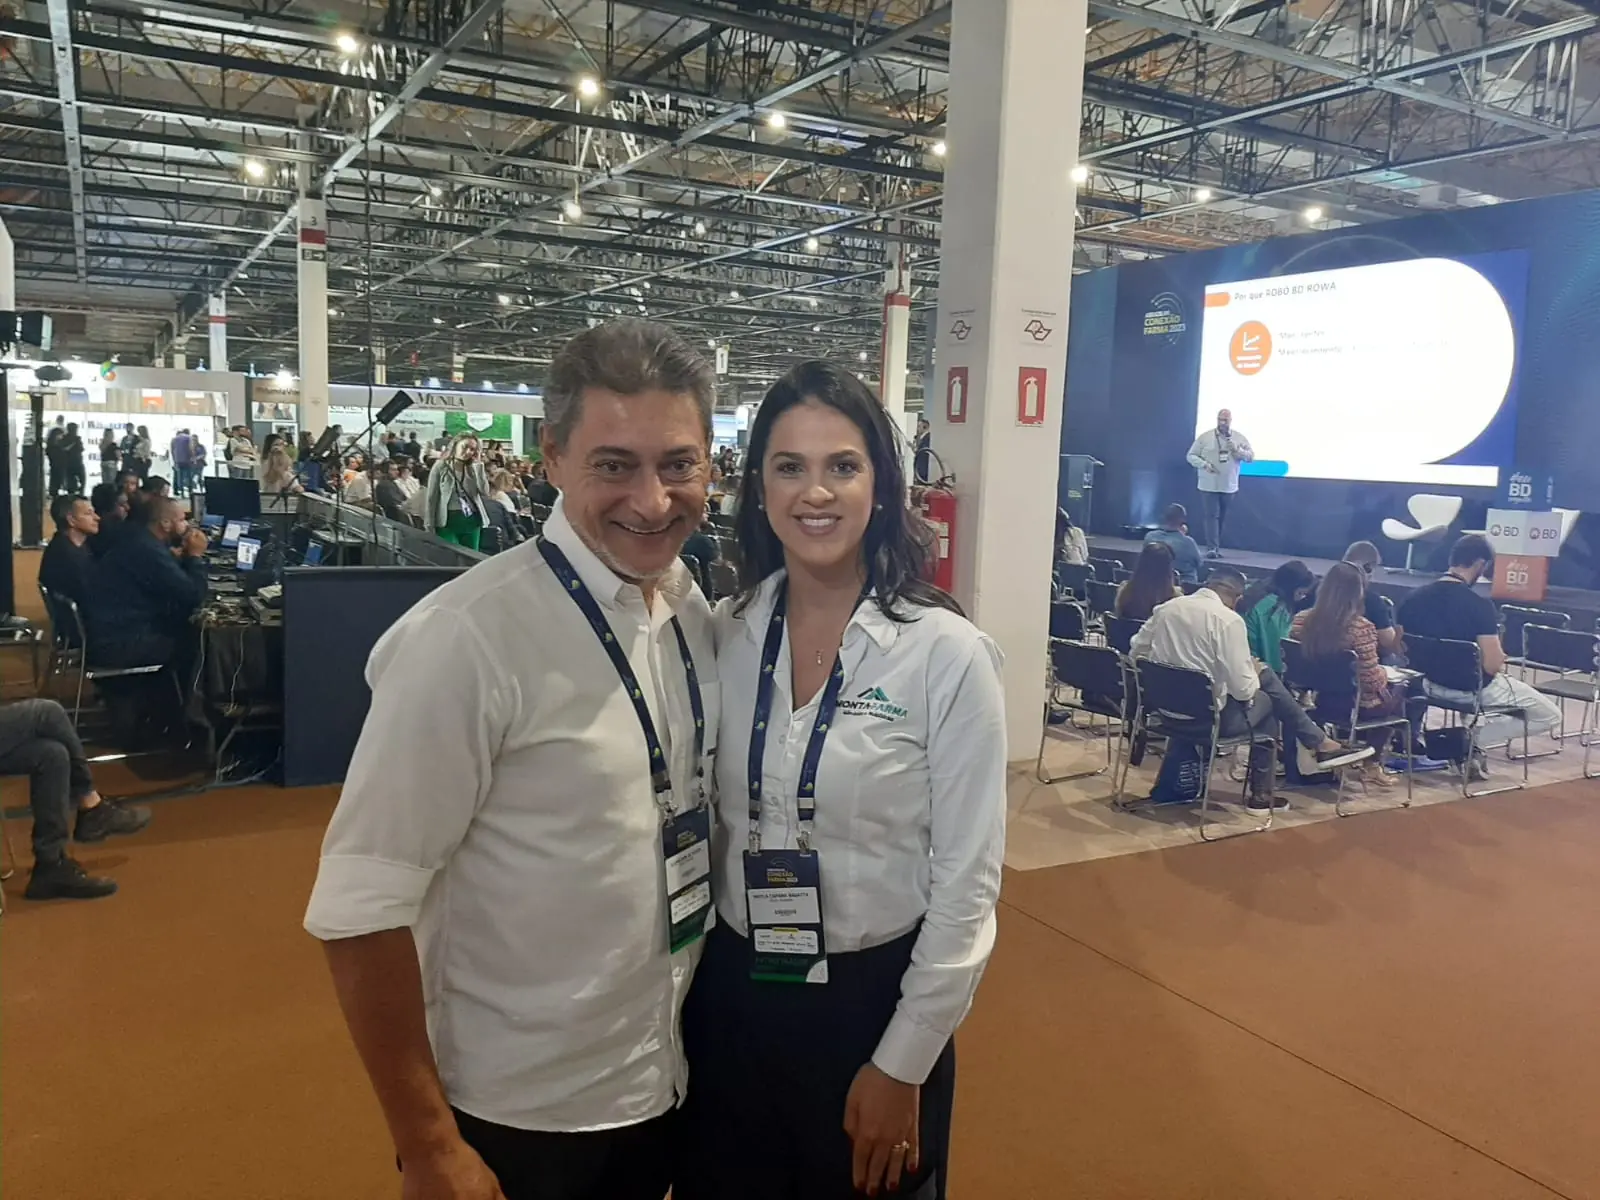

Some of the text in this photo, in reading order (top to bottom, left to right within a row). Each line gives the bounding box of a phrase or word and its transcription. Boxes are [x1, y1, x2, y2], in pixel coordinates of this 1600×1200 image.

[1291, 285, 1304, 295] BD
[1307, 281, 1337, 293] ROWA
[1509, 483, 1532, 497] BD
[1503, 526, 1520, 537] BD
[1541, 529, 1558, 540] BD
[1506, 572, 1528, 584] BD
